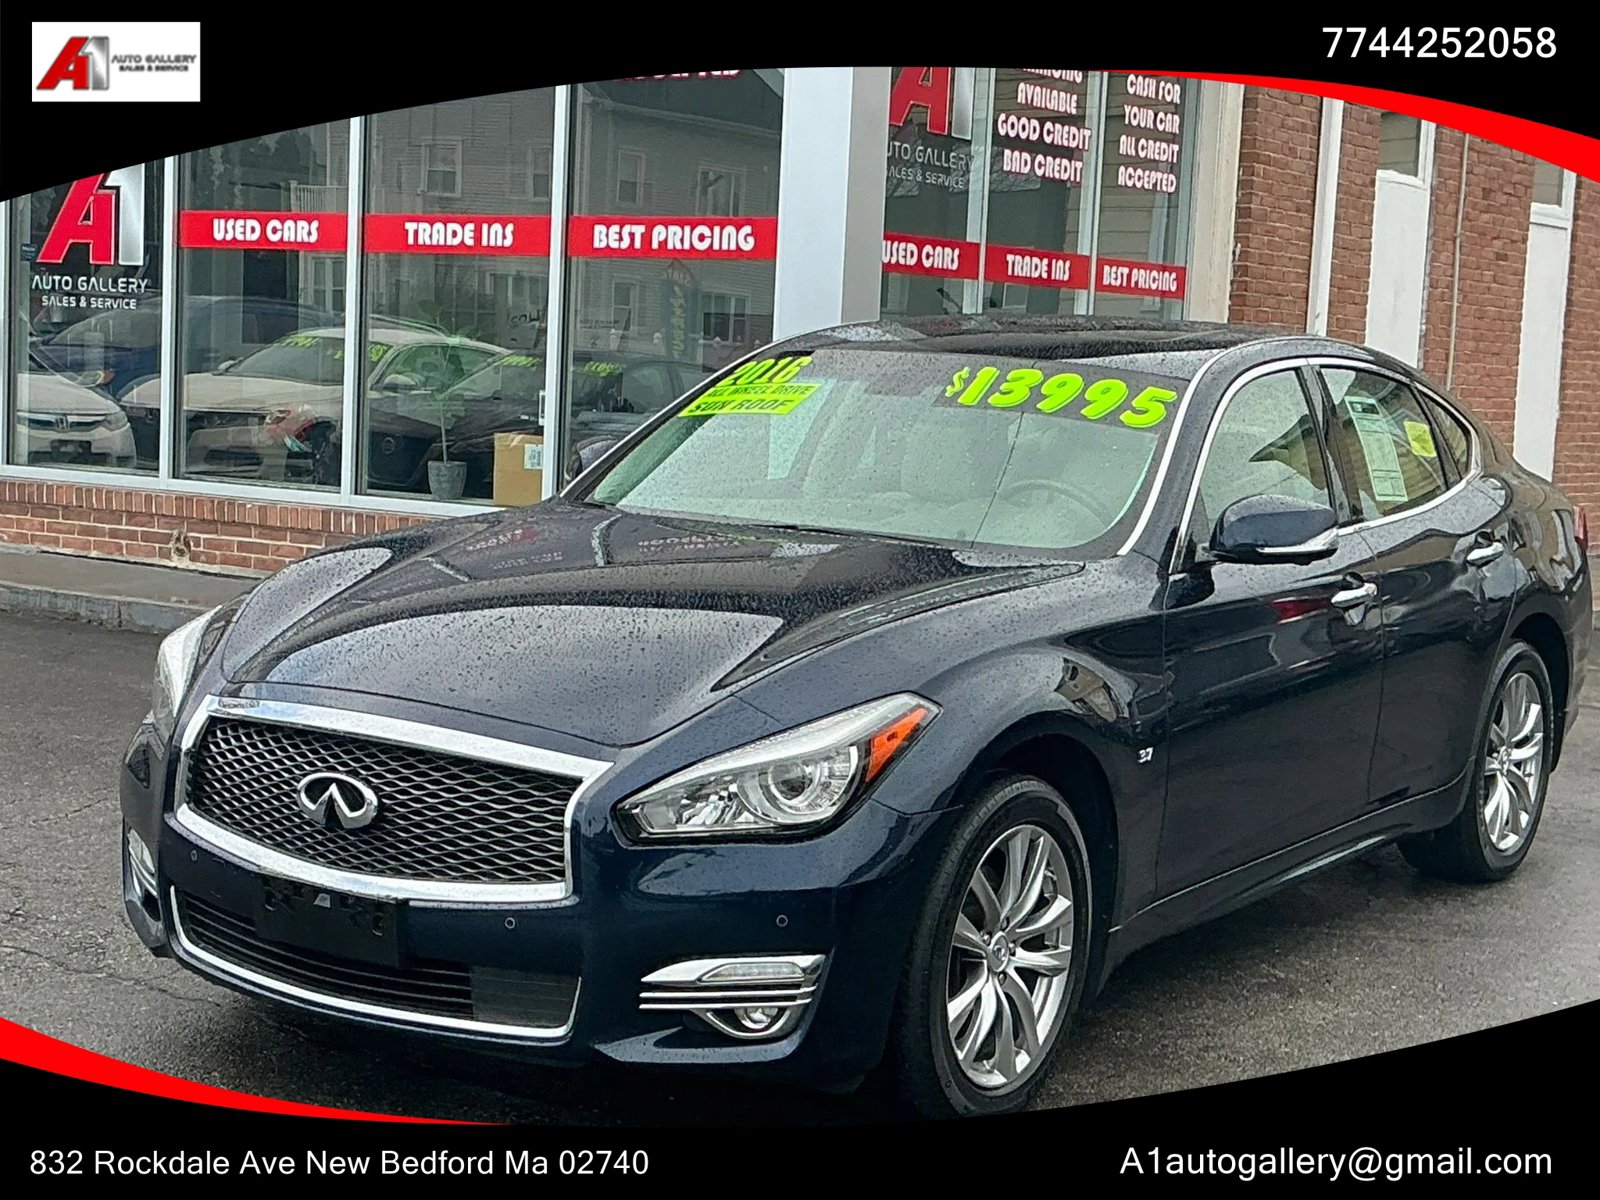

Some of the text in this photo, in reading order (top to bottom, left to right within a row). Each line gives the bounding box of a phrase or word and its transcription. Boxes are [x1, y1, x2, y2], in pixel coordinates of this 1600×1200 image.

[1017, 82, 1078, 115] AVAILABLE
[1127, 74, 1181, 104] CASH FOR
[997, 112, 1092, 150] GOOD CREDIT
[1123, 104, 1181, 134] YOUR CAR
[886, 141, 975, 173] UTO GALLERY
[1119, 134, 1179, 163] ALL CREDIT
[886, 165, 913, 180] ALES
[925, 172, 965, 188] SERVICE
[1003, 148, 1083, 182] BAD CREDIT
[1117, 165, 1177, 193] ACCEPTED
[36, 161, 146, 266] A1
[213, 218, 320, 244] USED CARS
[404, 221, 515, 248] TRADE INS
[593, 223, 755, 252] BEST PRICING
[881, 239, 960, 271] USED CARS
[1006, 253, 1071, 282] TRADE INS
[32, 275, 148, 293] AUTO GALLERY
[1102, 265, 1177, 292] BEST PRICING
[41, 295, 137, 310] SALES & SERVICE
[715, 356, 813, 388] 2016
[731, 399, 794, 411] ROOF
[945, 366, 1178, 429] $13995
